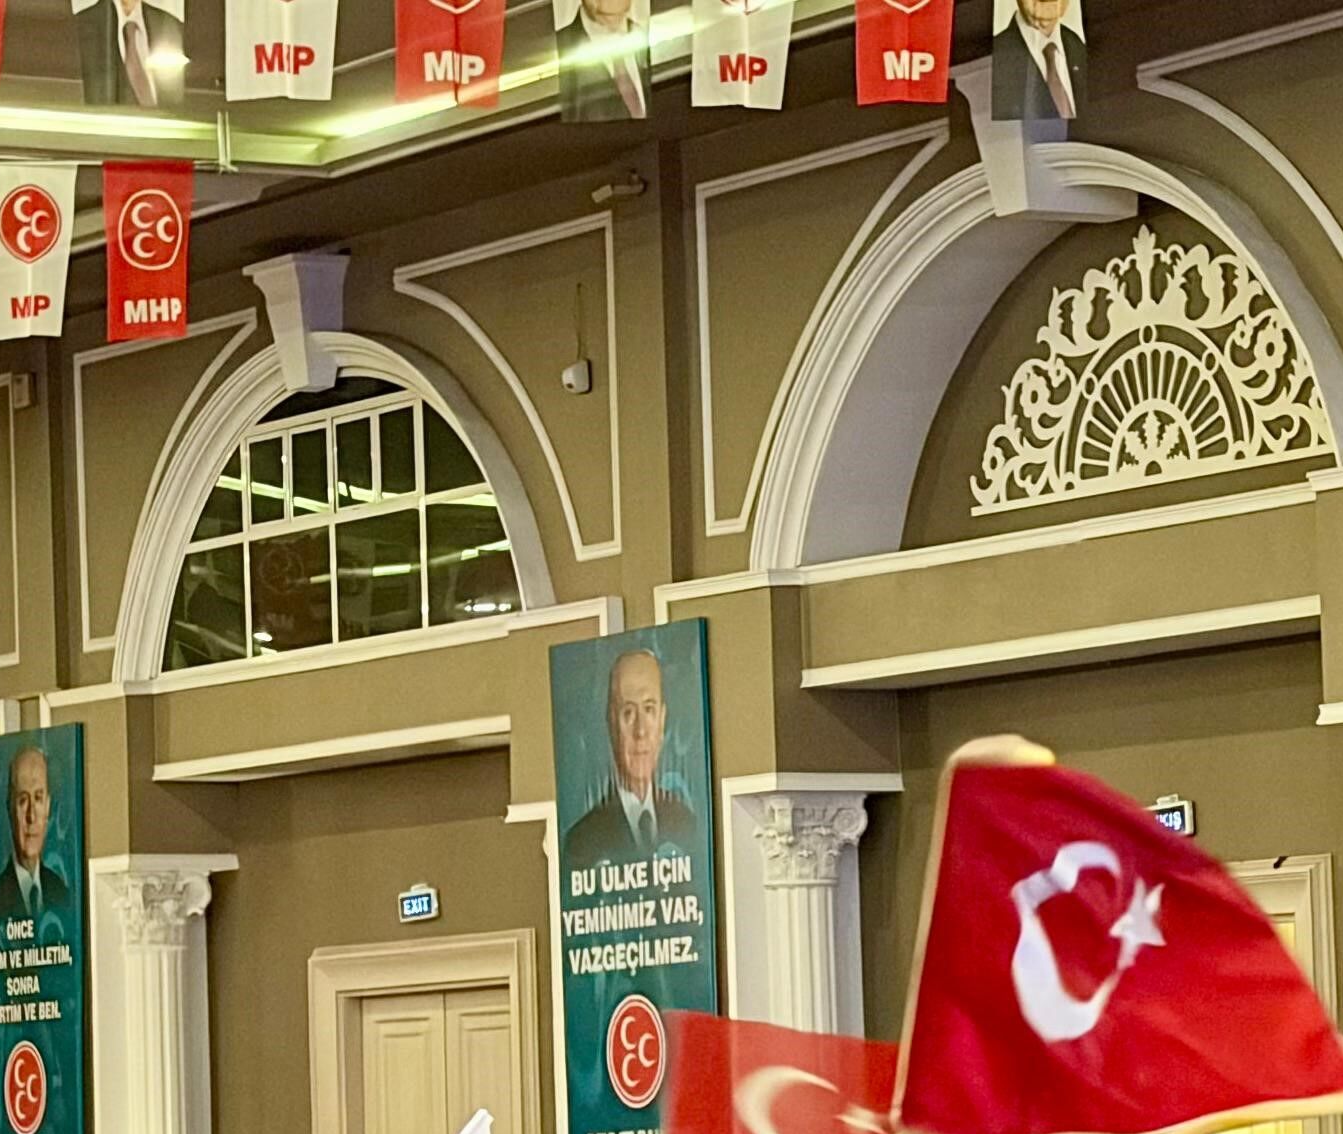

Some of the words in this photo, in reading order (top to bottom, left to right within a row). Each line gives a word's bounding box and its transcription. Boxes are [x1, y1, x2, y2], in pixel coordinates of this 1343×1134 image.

[123, 297, 182, 324] MHP
[571, 868, 595, 896] BU
[601, 860, 648, 893] ÜLKE
[653, 851, 691, 893] İÇİN
[403, 896, 429, 915] EXIT
[563, 894, 656, 937] YEMİNİMİZ
[660, 895, 703, 926] VAR,
[6, 917, 34, 940] ÖNCE
[9, 949, 22, 969] VE
[23, 940, 72, 967] MİLLETİM,
[569, 934, 698, 976] VAZGEÇİLMEZ.
[6, 975, 40, 997] SONRA
[24, 1002, 37, 1021] VE
